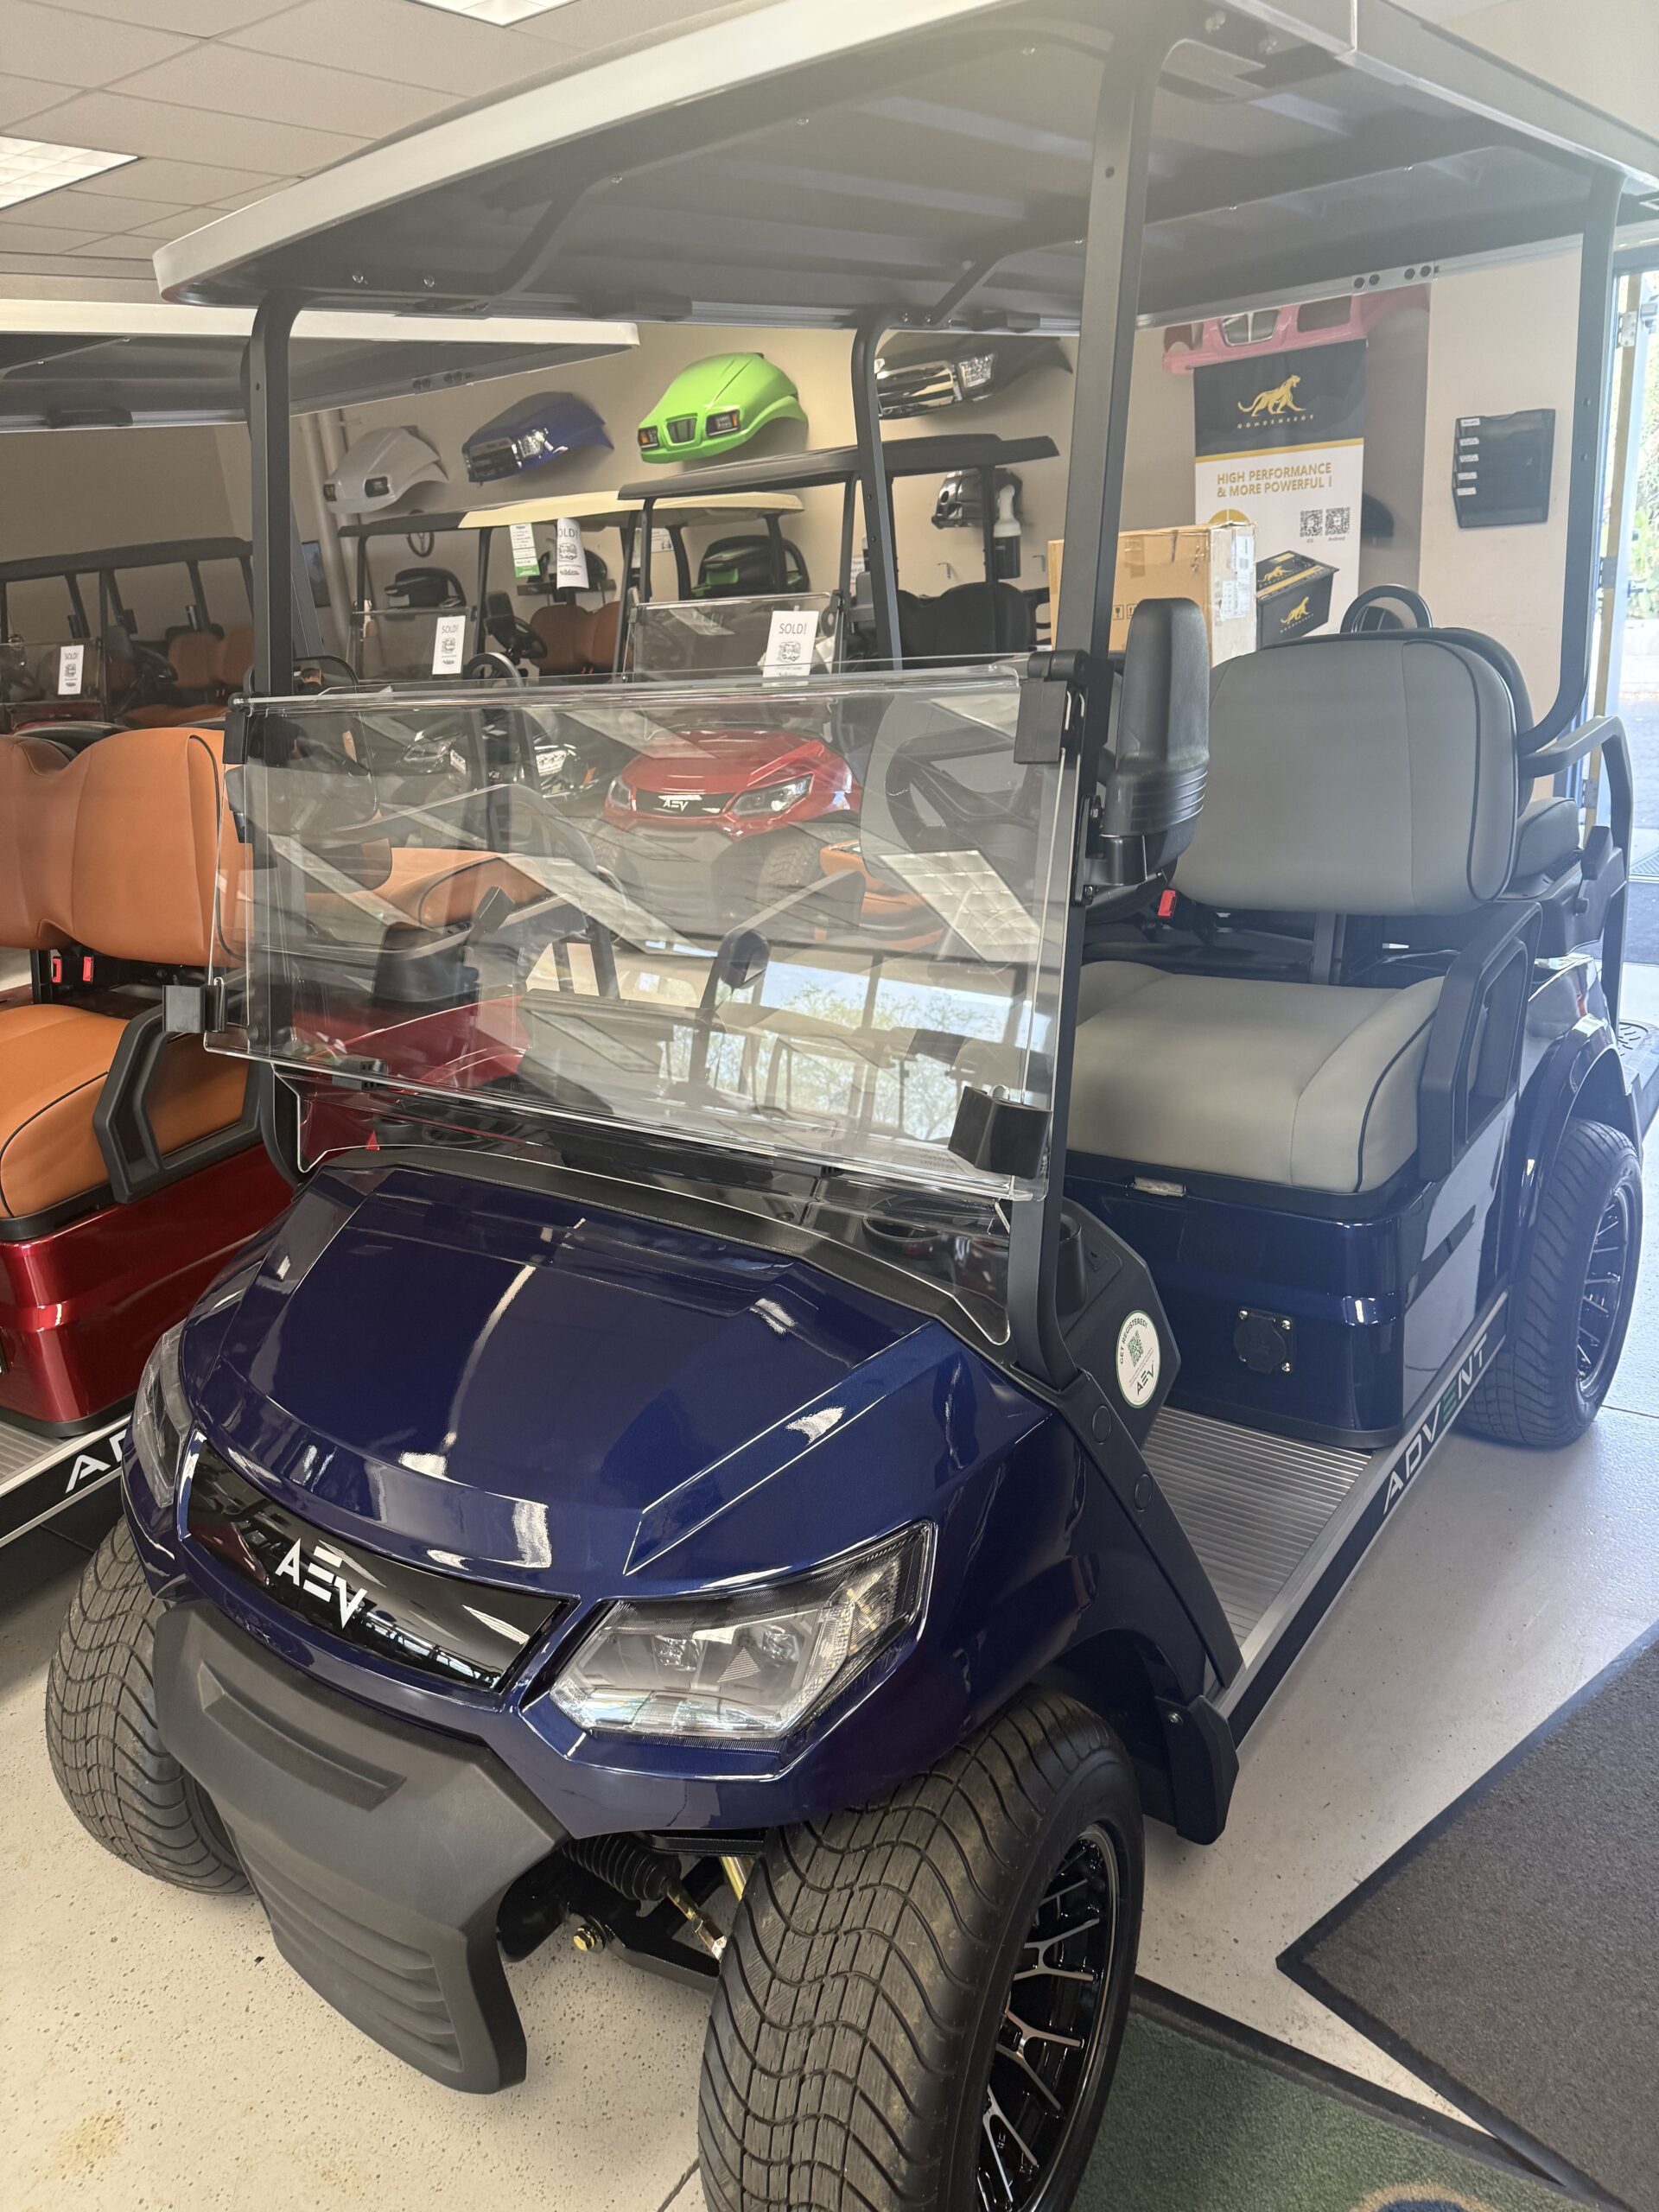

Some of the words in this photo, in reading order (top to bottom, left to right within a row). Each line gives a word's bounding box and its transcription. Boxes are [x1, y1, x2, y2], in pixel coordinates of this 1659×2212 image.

[1217, 472, 1245, 485] HIGH
[1249, 462, 1332, 481] PERFORMANCE
[1217, 486, 1226, 498] &
[1229, 484, 1262, 496] MORE
[1264, 477, 1325, 493] POWERFUL
[779, 623, 807, 634] SOLD!
[1122, 1318, 1148, 1345] REGISTERED!
[1136, 1363, 1154, 1395] AEV
[1383, 1333, 1487, 1516] ADVENT
[275, 1538, 367, 1630] AEV
